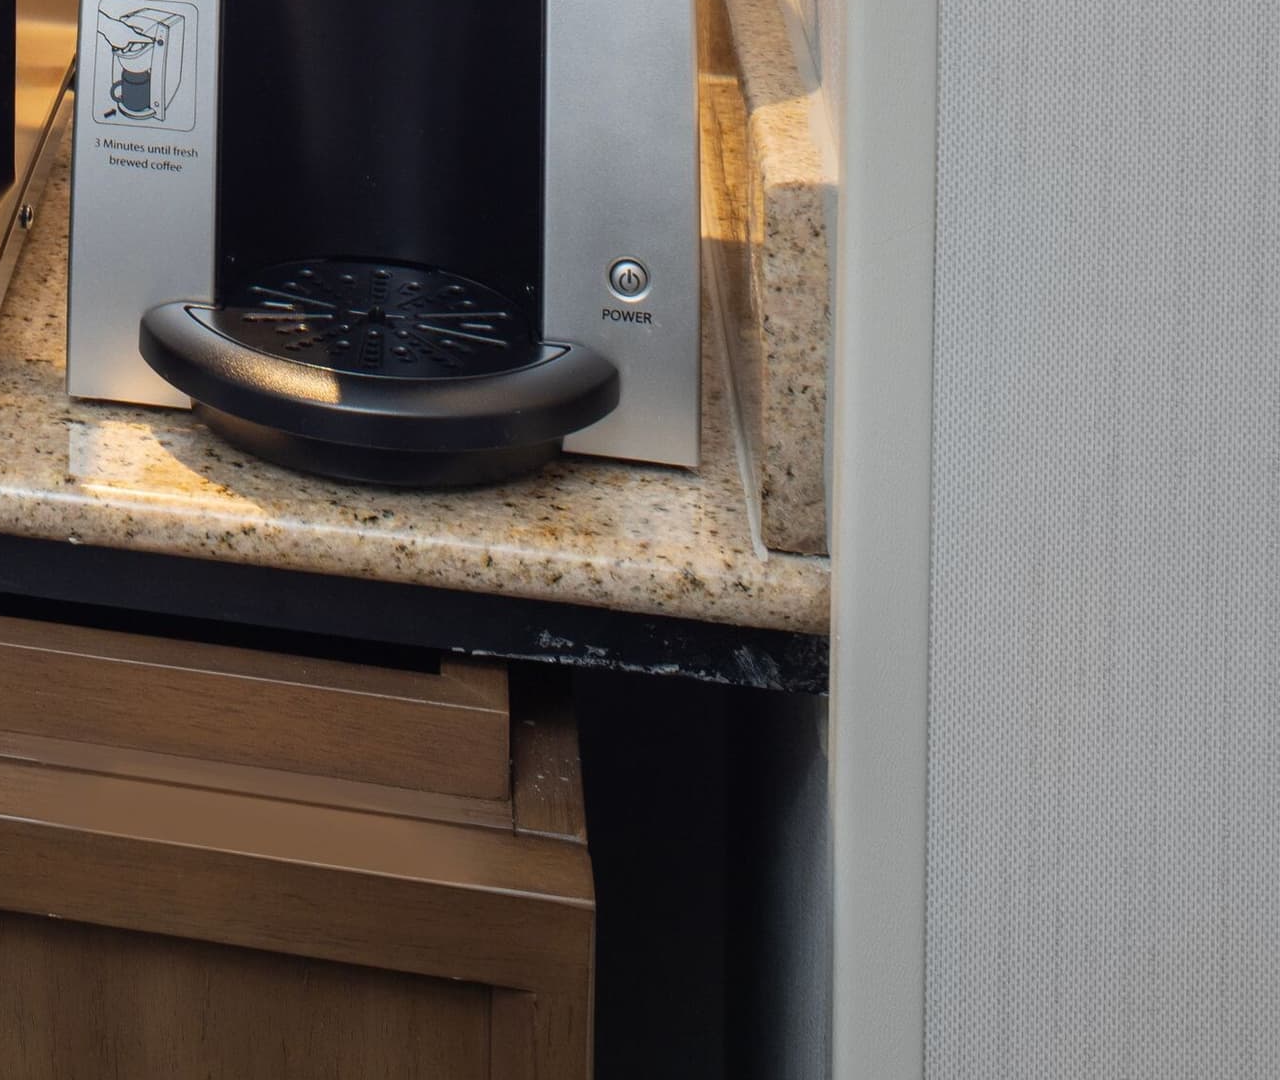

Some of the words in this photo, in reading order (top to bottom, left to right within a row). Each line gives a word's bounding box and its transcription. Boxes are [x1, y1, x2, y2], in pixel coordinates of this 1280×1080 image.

[95, 138, 101, 147] 3
[103, 138, 145, 153] Minutes
[147, 145, 171, 155] until
[173, 147, 198, 158] fresh
[109, 154, 148, 169] brewed
[150, 161, 183, 172] coffee
[602, 309, 652, 324] POWER
